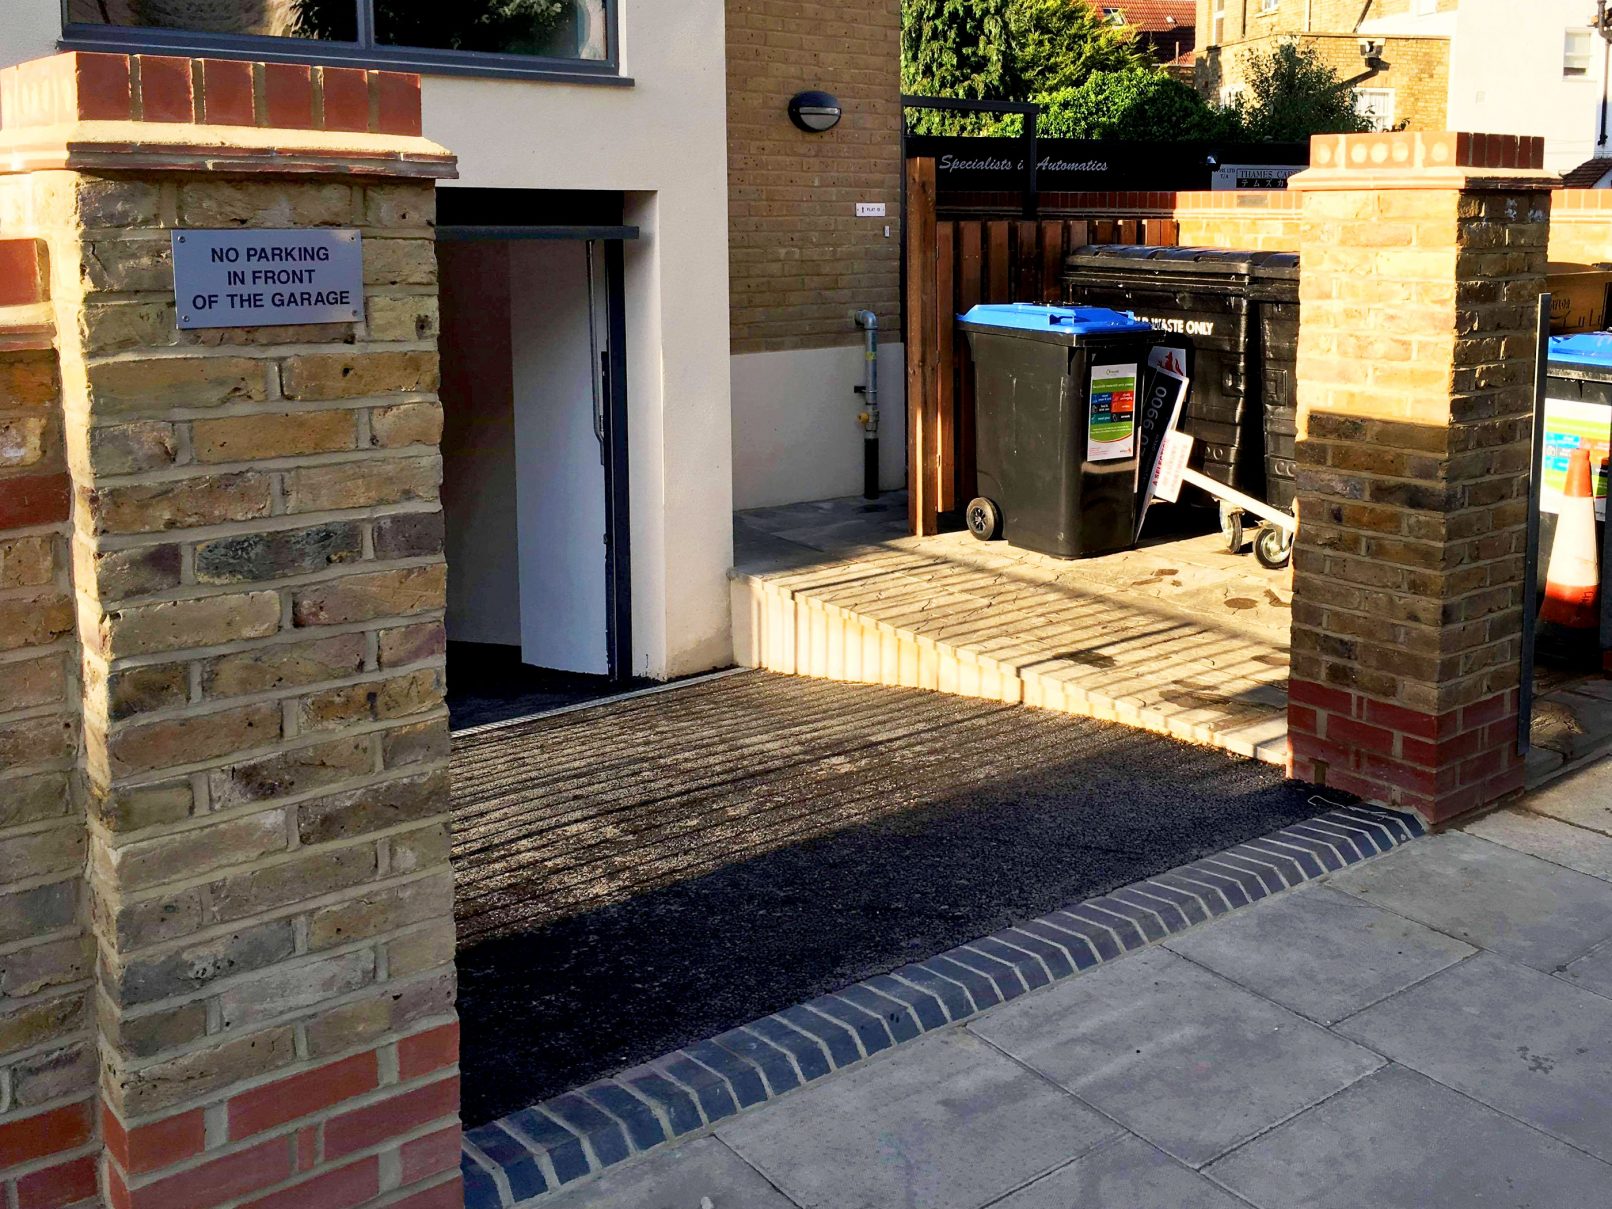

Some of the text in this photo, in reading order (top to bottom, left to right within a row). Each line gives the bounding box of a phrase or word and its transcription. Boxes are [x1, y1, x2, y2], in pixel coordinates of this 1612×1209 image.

[939, 154, 1012, 173] Specialists
[1035, 156, 1108, 171] Automatics
[1240, 170, 1273, 178] THAMES
[211, 246, 330, 263] NO PARKING
[227, 269, 316, 286] IN FRONT
[192, 290, 350, 310] OF THE GARAGE
[1151, 317, 1184, 333] WASTE
[1186, 320, 1214, 336] ONLY
[1143, 386, 1167, 431] 9900
